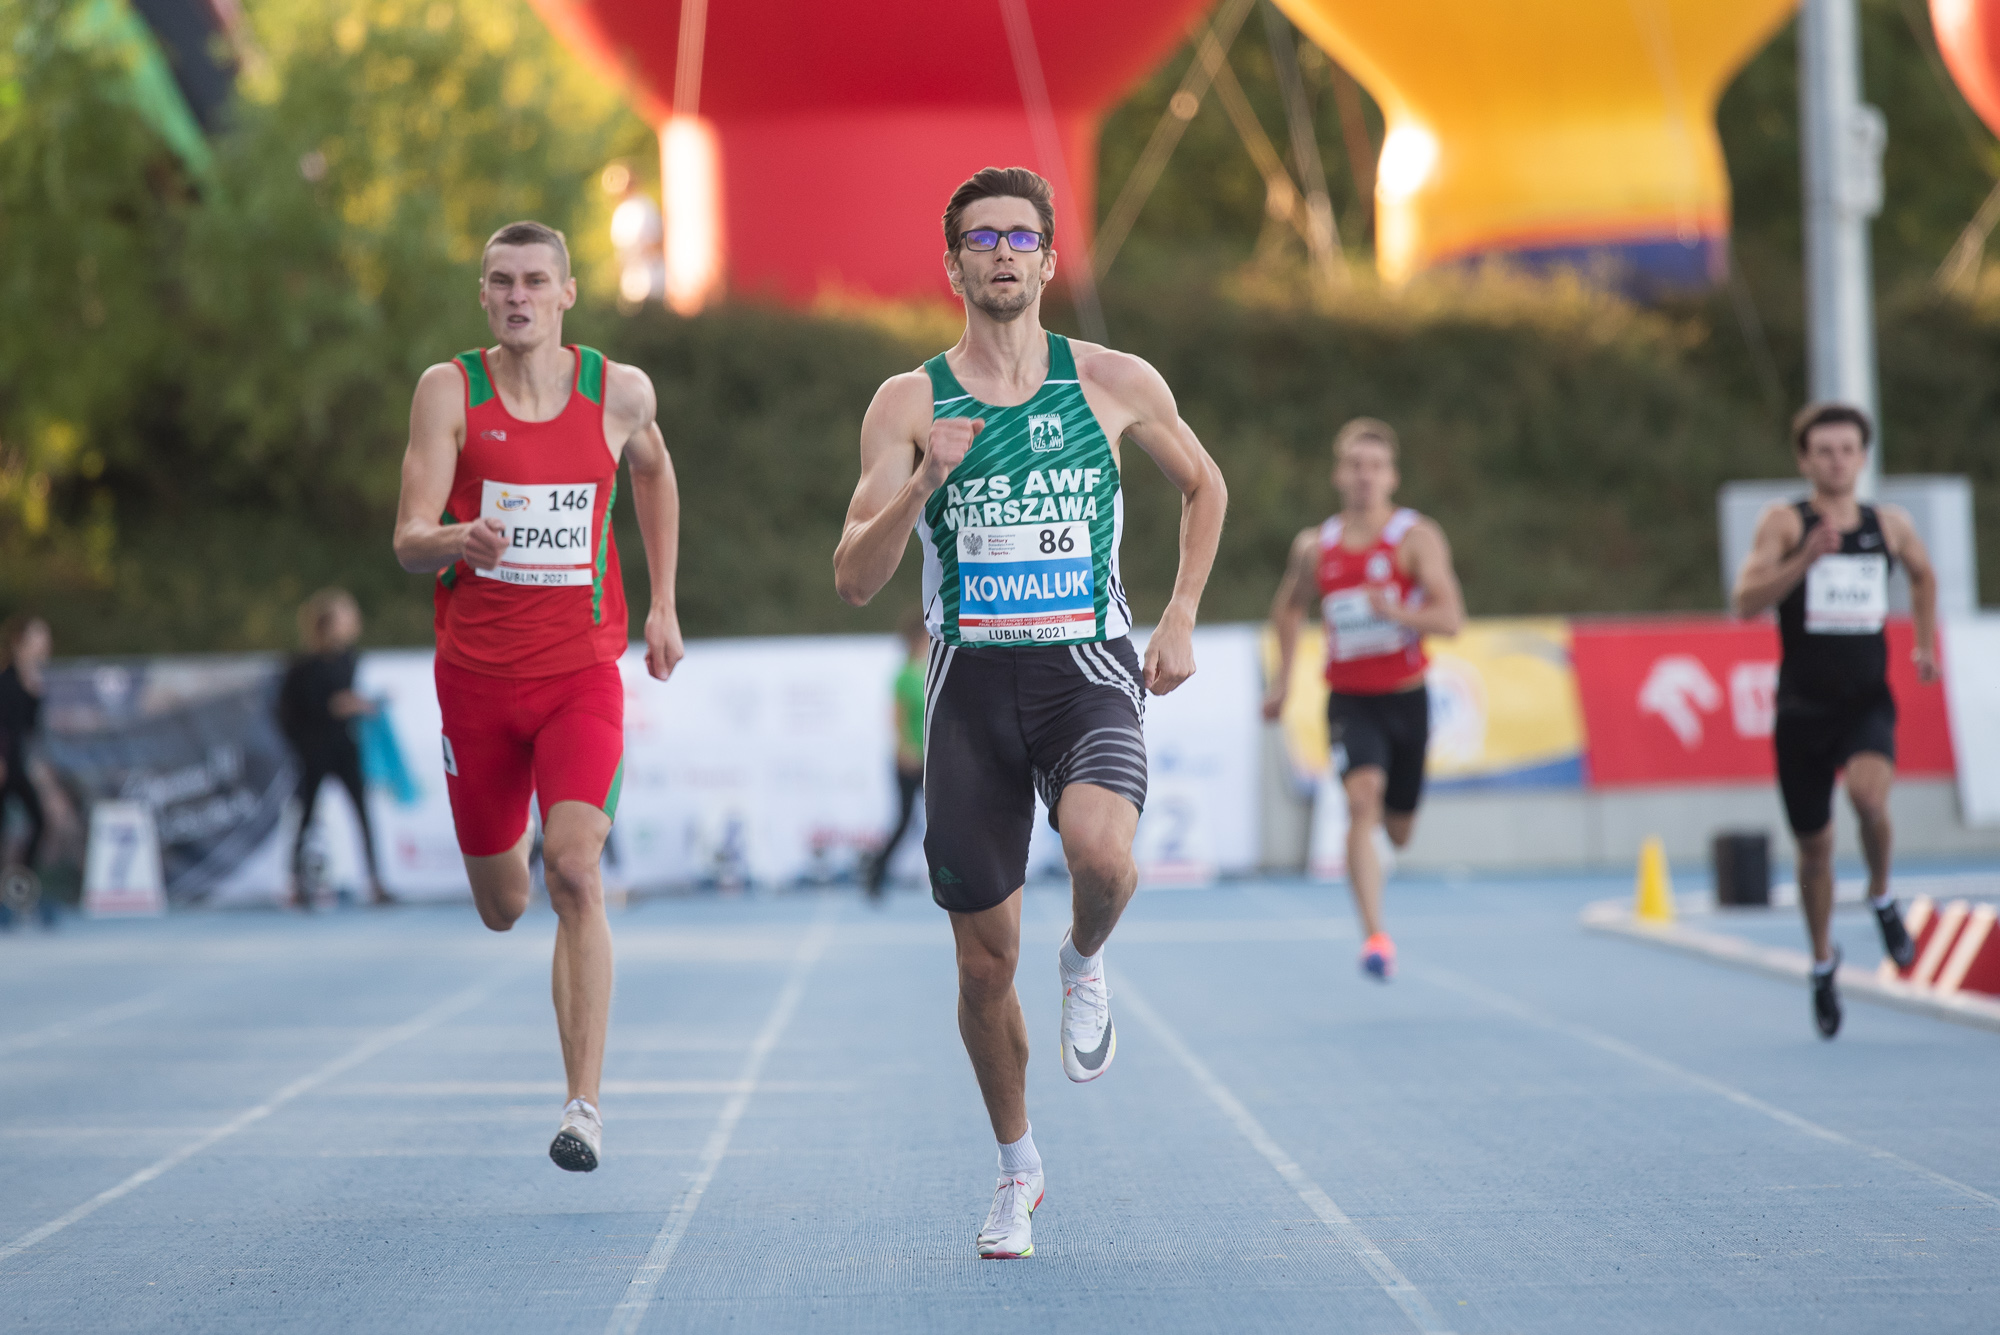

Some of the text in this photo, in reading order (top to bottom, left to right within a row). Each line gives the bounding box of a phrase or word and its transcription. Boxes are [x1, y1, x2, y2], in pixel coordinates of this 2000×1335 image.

[549, 489, 588, 511] 146
[947, 468, 1102, 506] AZS AWF
[943, 496, 1098, 531] WARSZAWA
[1039, 526, 1075, 554] 86
[500, 570, 568, 584] LUBLIN 2021
[964, 570, 1089, 602] KOWALUK
[989, 626, 1066, 640] LUBLIN 2021
